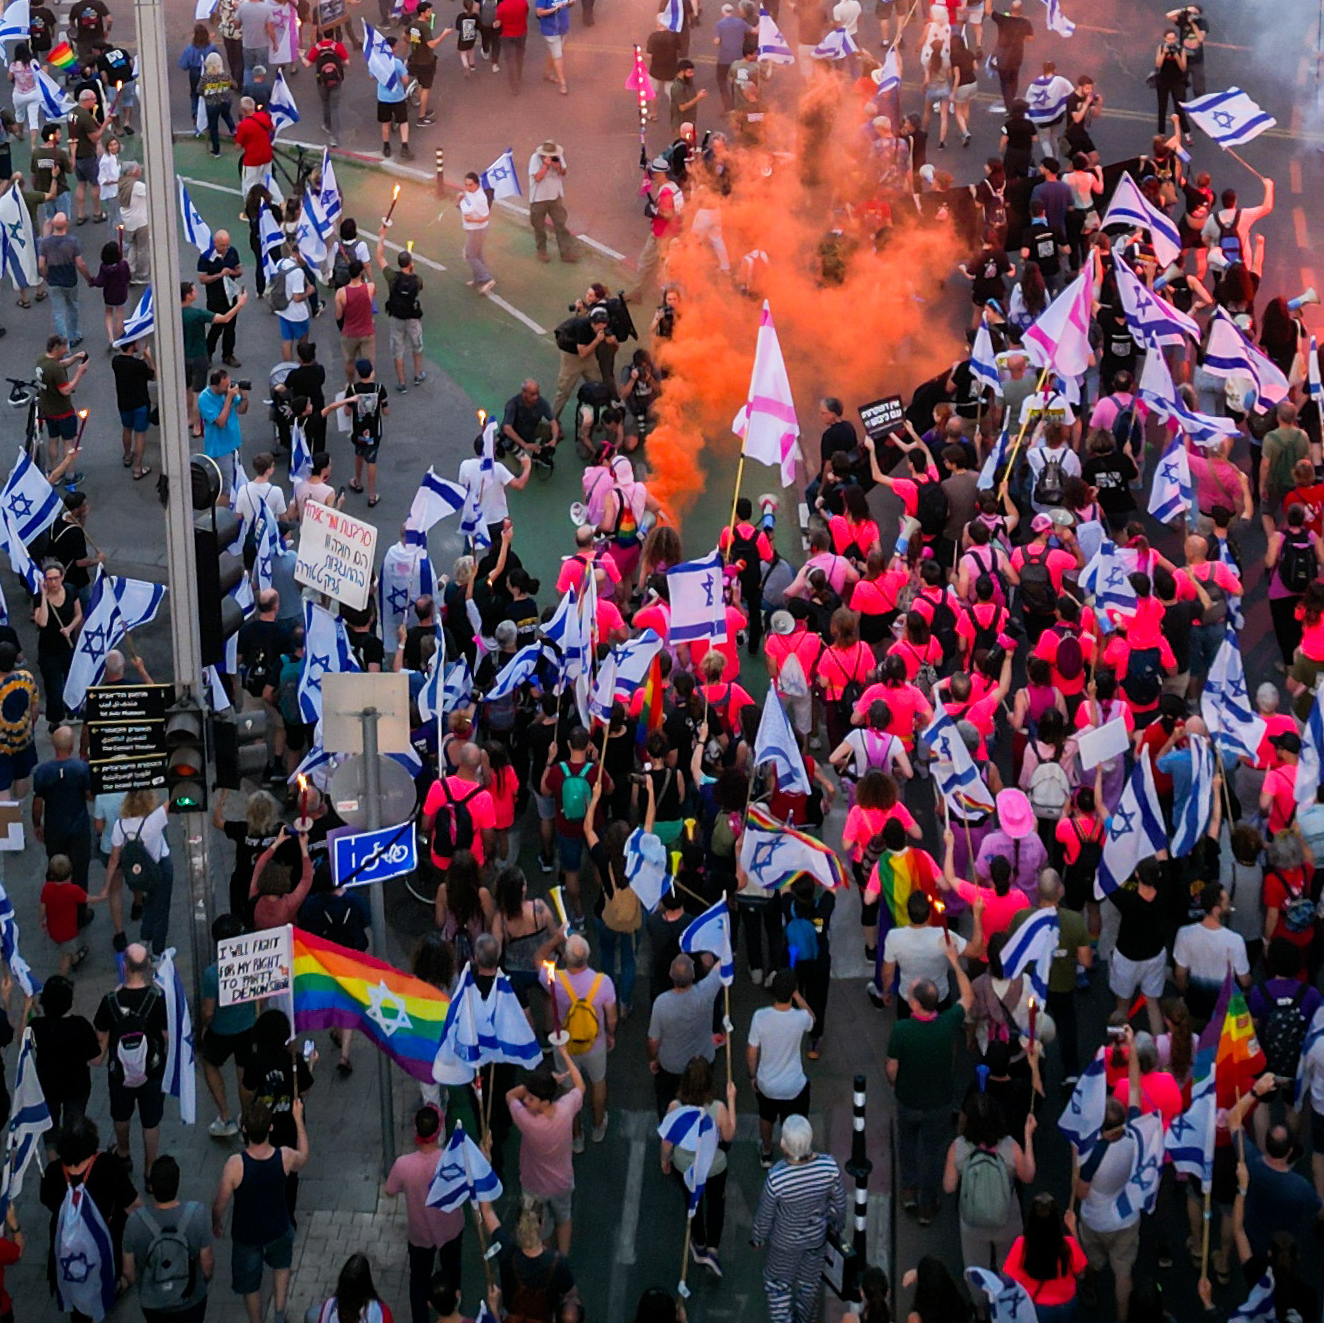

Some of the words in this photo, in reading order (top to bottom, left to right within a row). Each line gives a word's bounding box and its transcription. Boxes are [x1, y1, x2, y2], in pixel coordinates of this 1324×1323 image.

[353, 551, 369, 569] הם
[219, 947, 227, 960] I
[229, 942, 249, 958] WILL
[252, 936, 281, 954] FIGHT
[219, 963, 236, 978] FOR
[237, 960, 251, 975] MY
[220, 978, 238, 990] TO
